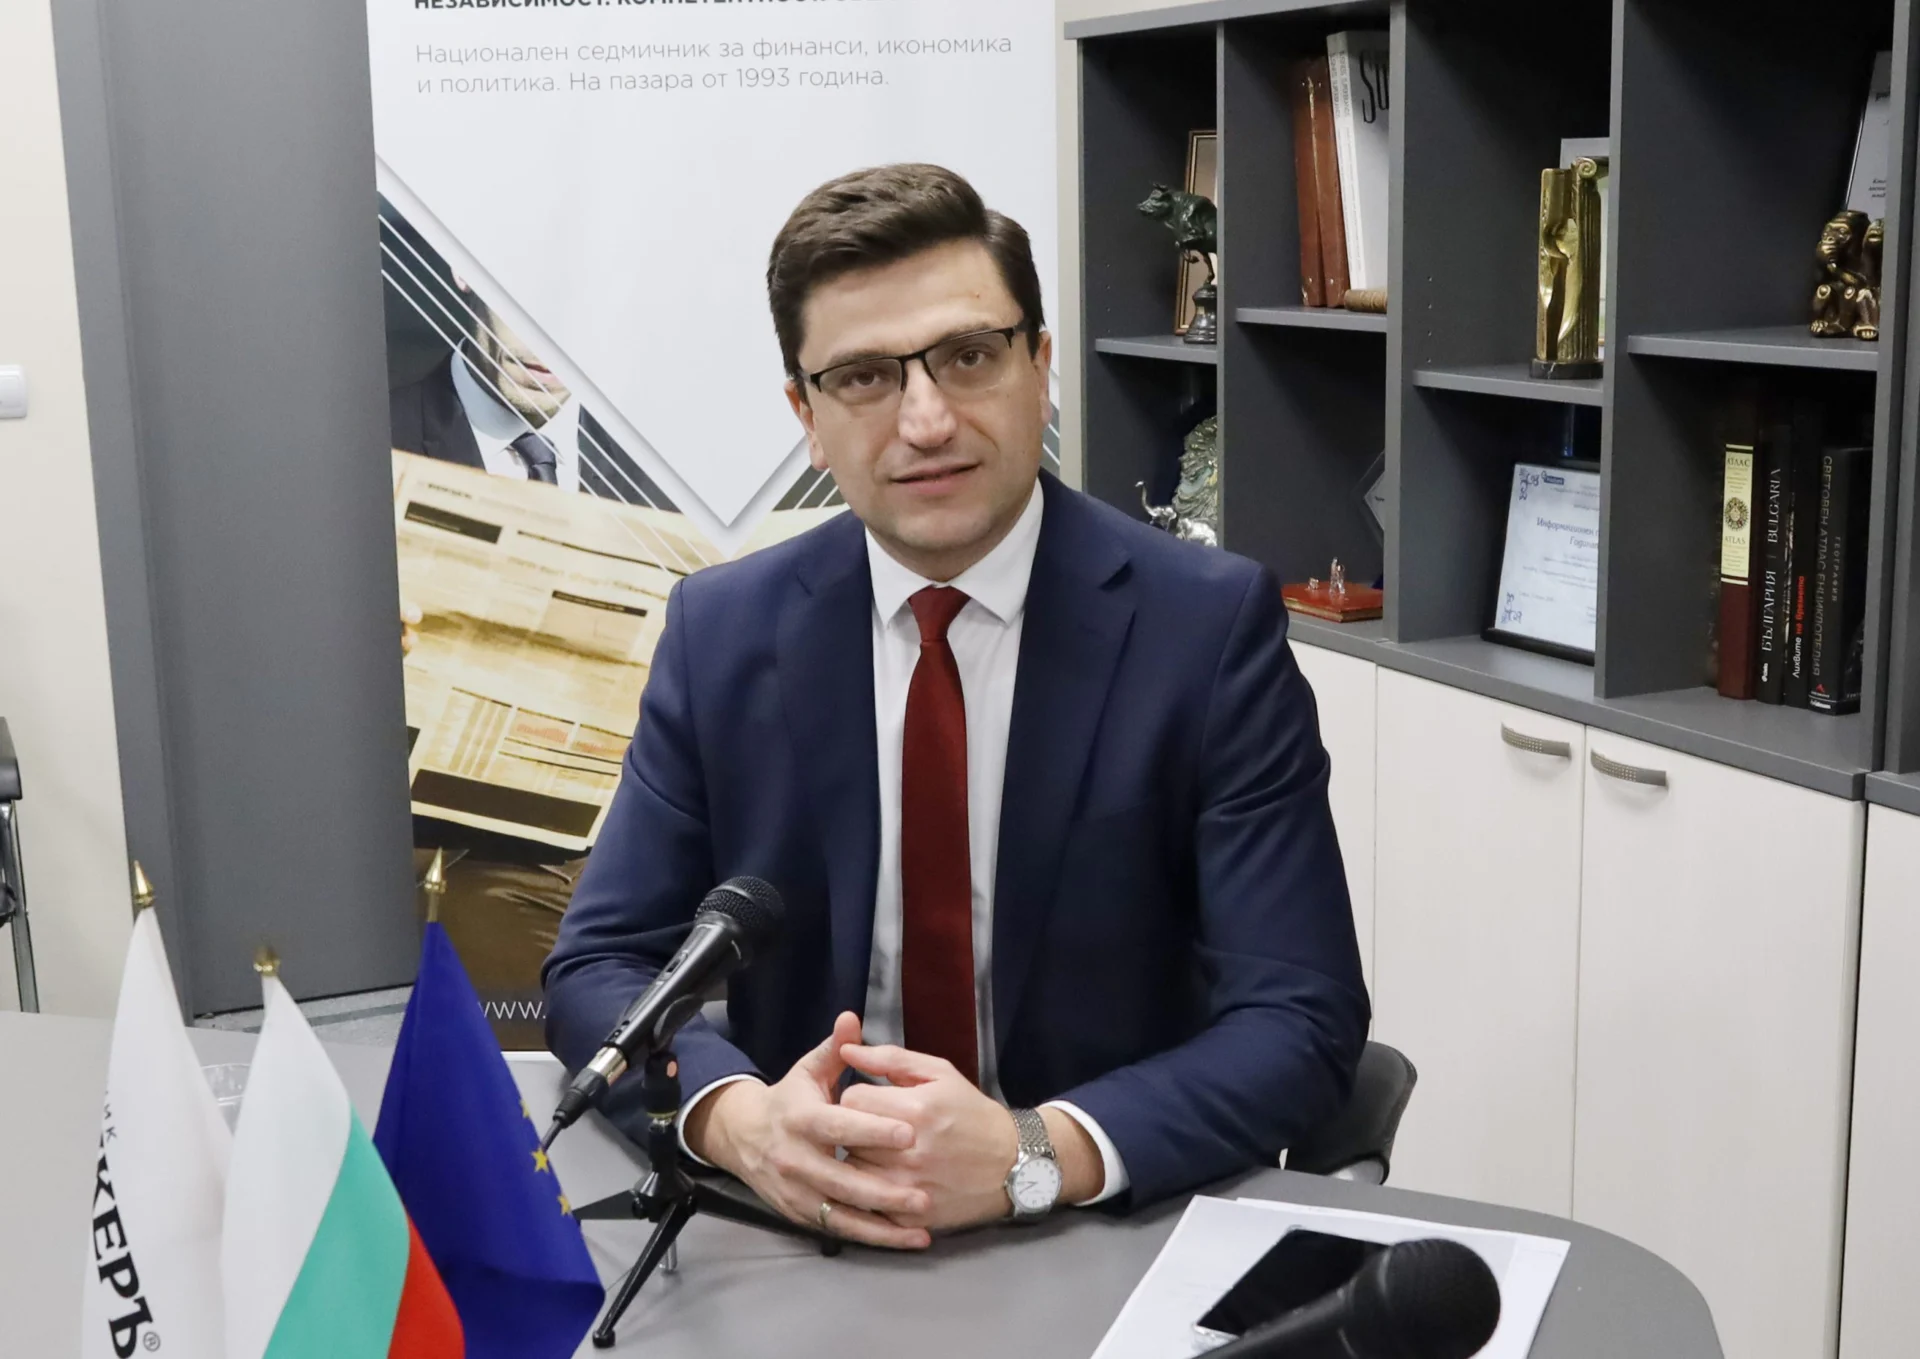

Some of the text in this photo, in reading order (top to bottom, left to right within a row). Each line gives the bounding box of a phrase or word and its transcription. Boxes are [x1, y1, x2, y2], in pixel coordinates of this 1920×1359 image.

[416, 36, 1012, 65] Национален седмичник за финанси, икономика
[417, 67, 889, 94] и политика. На пазара от 1993 година.
[1767, 468, 1781, 543] BULGARIA
[1819, 455, 1833, 525] СВЕТОВЕН
[1818, 527, 1828, 570] АТЛАС
[1831, 536, 1841, 602] ГЕОГРАФИЯ
[1761, 569, 1776, 652] БЪЛГАРИЯ
[92, 1132, 154, 1359] КЕРЪ
